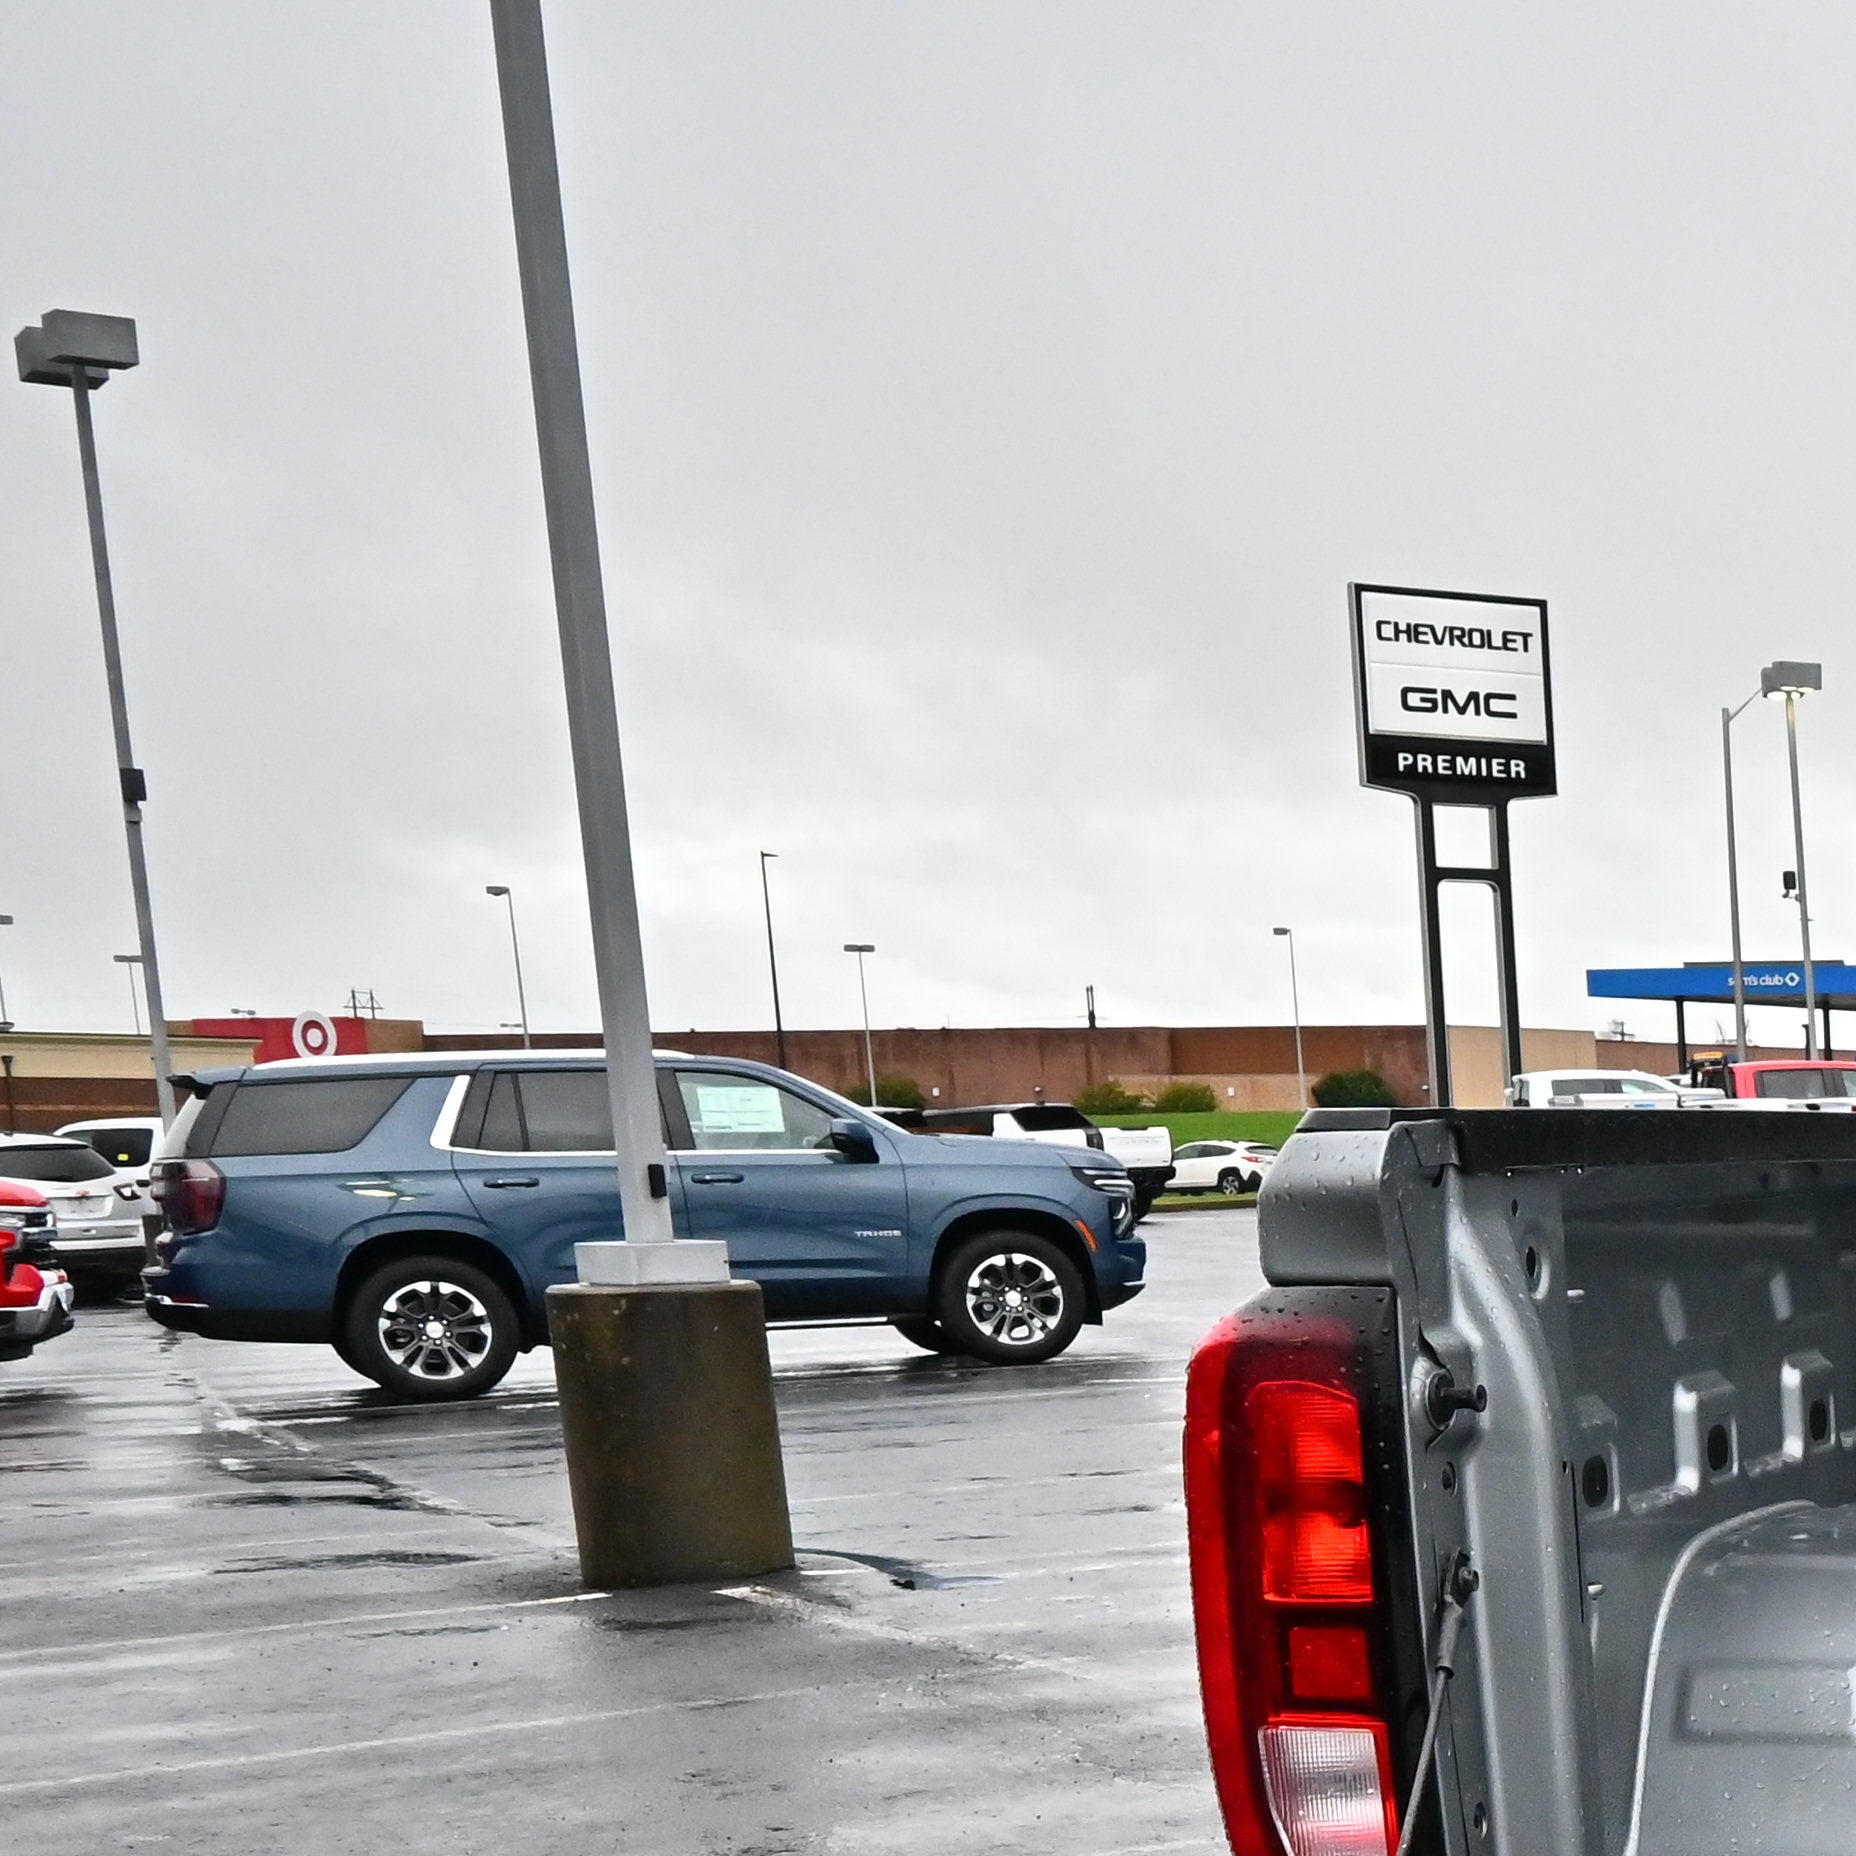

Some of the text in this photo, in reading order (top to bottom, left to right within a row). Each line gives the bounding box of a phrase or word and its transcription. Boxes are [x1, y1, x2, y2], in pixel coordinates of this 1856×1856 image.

[1375, 619, 1533, 653] CHEVROLET
[1400, 686, 1518, 719] GMC
[1397, 752, 1527, 779] PREMIER
[1728, 974, 1784, 987] sm's club
